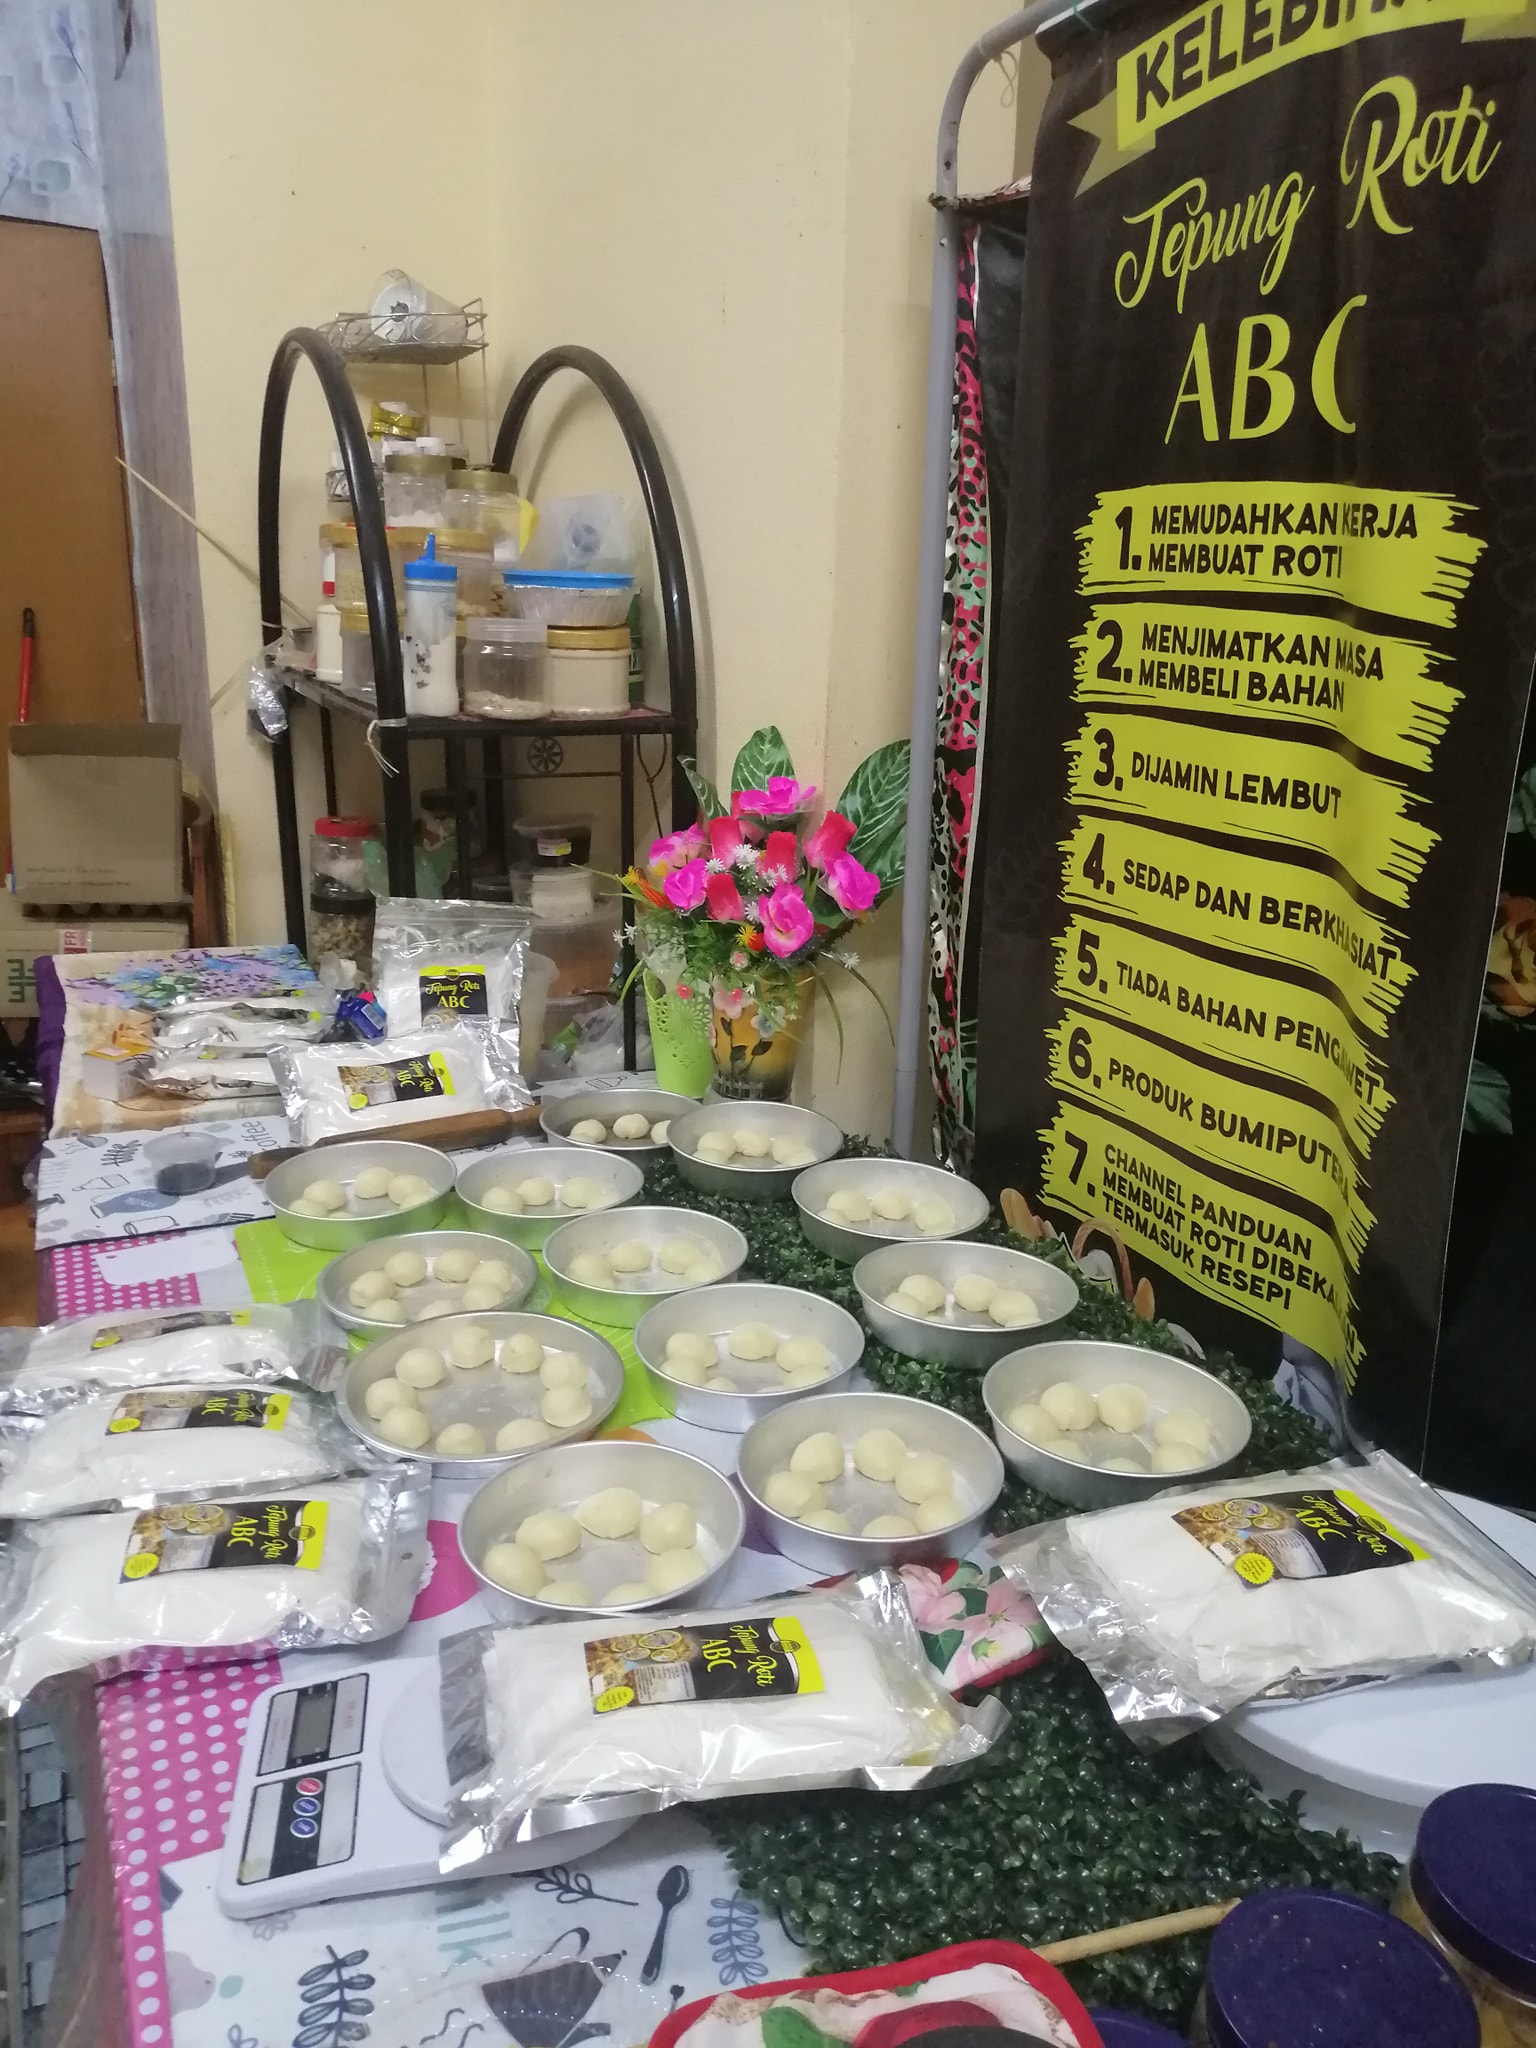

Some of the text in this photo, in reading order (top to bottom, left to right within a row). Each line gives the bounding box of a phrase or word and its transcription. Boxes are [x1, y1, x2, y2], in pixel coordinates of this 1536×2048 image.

[1136, 0, 1433, 123] KELEB
[1114, 75, 1502, 314] Tepung Roti
[1165, 294, 1368, 444] ABC
[1115, 502, 1418, 571] 1. MEMUDAHKAN KERJA
[1148, 543, 1343, 579] MEMBUAT ROTI
[1096, 620, 1384, 685] 2. MENJIMATKAN MASA
[1138, 659, 1345, 713] MEMBELI BAHAN
[1093, 728, 1342, 819] 3. DIJAMIN LEMBUT
[1082, 833, 1397, 980] 4. SEDAP DAN BERKHASIAT
[437, 995, 471, 1009] ABC
[1076, 930, 1381, 1106] 5. TIADA BAHAN PENGAWET
[396, 1069, 415, 1088] ABC
[241, 1120, 281, 1150] offee
[1068, 1026, 1350, 1208] 6. PRODUK BUMIPUTERA
[1064, 1130, 1313, 1261] 7. CHANNEL PANDUAN
[1102, 1166, 1186, 1231] MEMBUAT
[1190, 1220, 1245, 1264] ROTI
[1103, 1191, 1292, 1311] TERMASUK RESEPI
[200, 1396, 230, 1416] ABC
[227, 1515, 260, 1548] ABC
[1286, 1507, 1347, 1542] ABC
[701, 1638, 737, 1673] ABC
[747, 1655, 778, 1687] Roti
